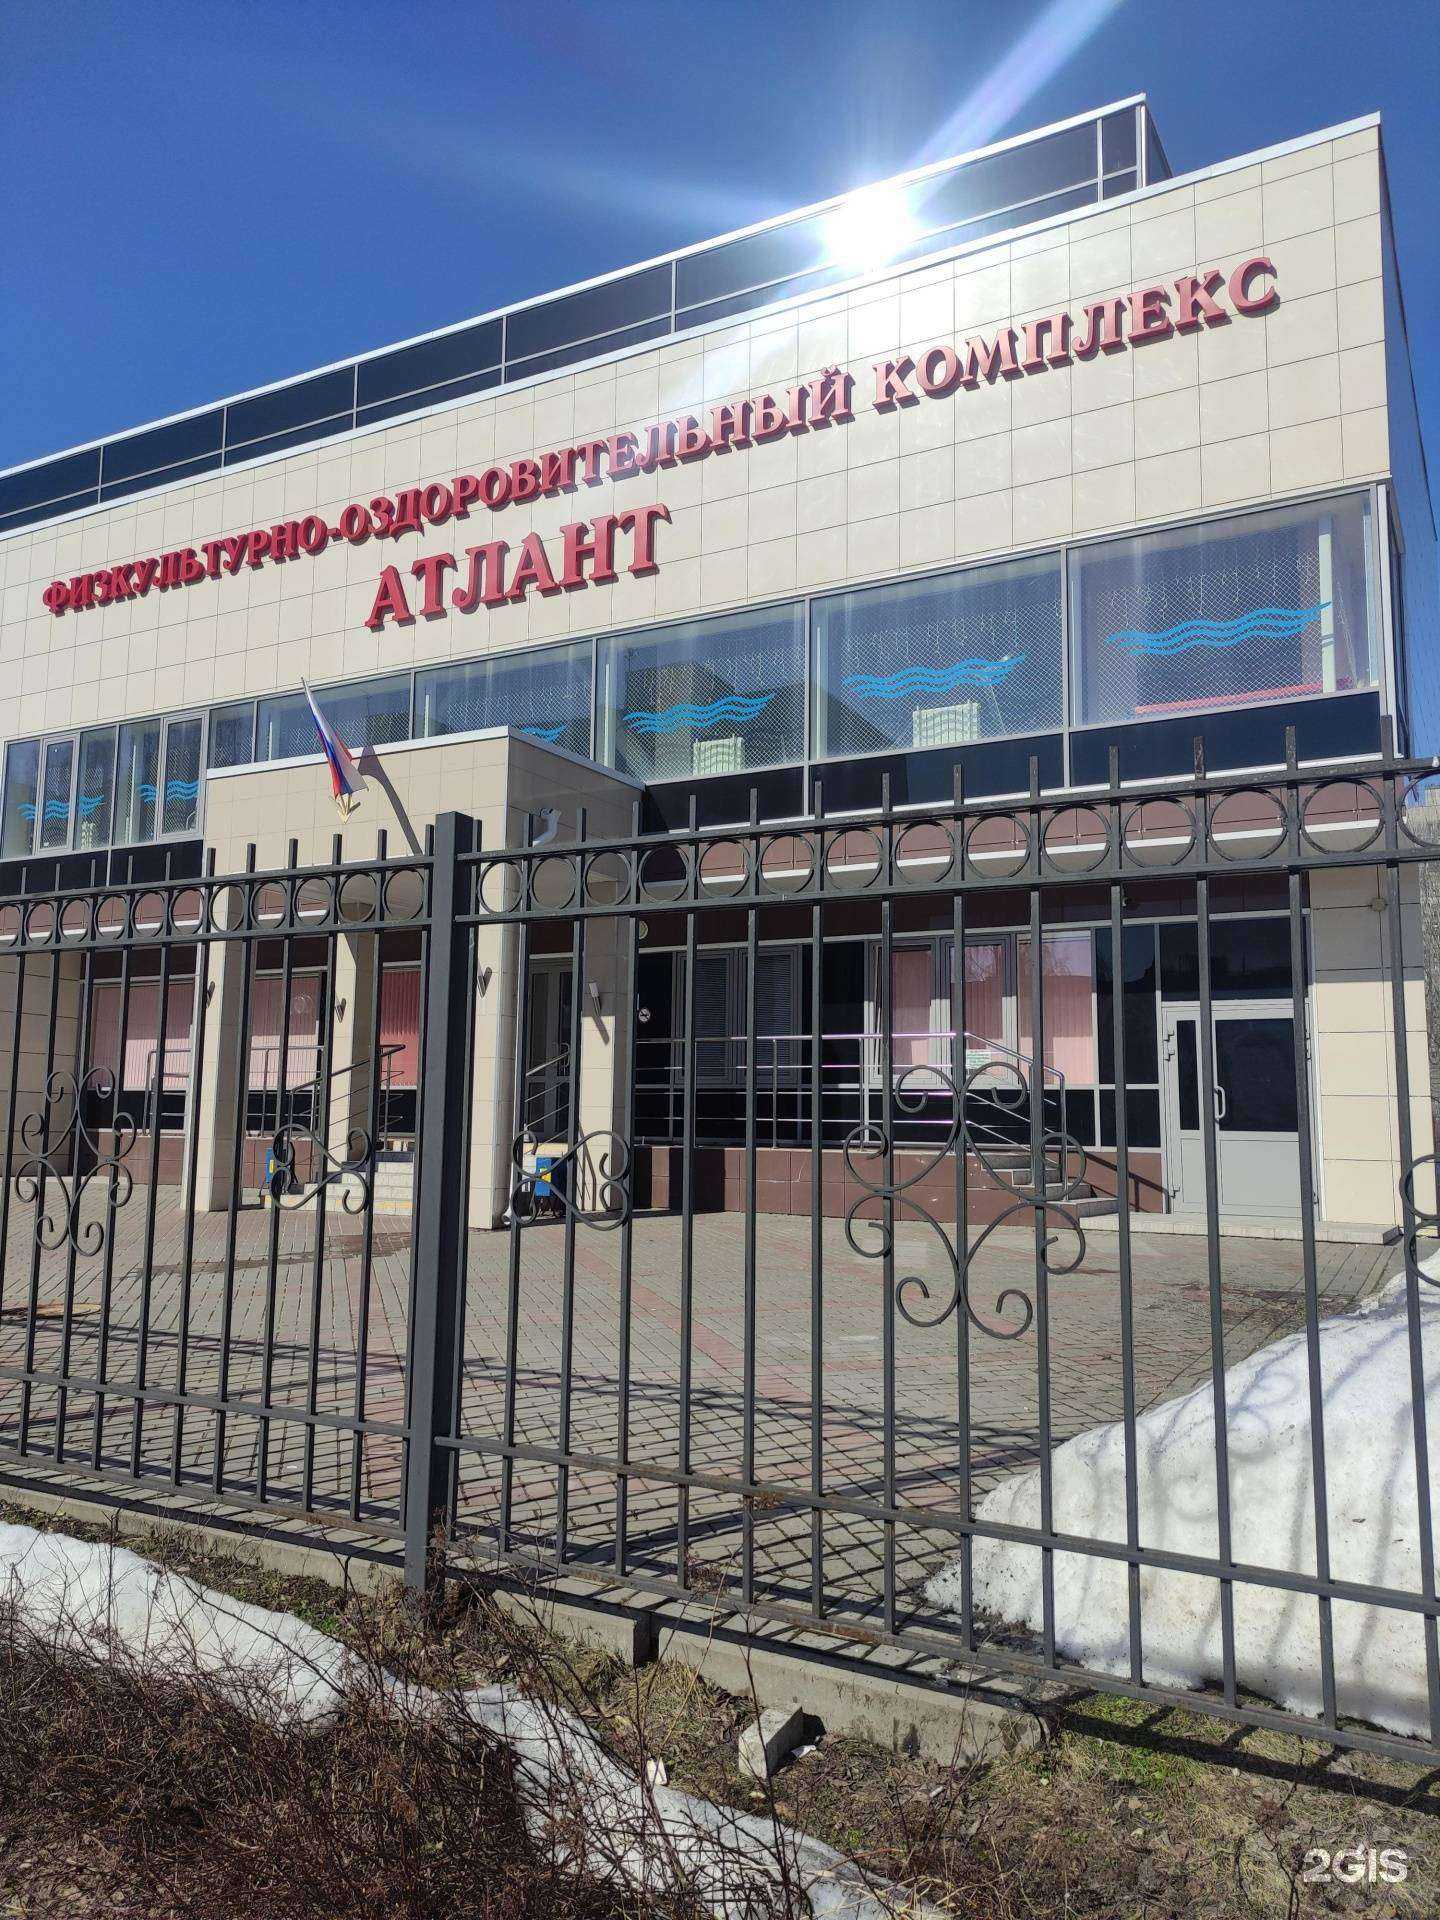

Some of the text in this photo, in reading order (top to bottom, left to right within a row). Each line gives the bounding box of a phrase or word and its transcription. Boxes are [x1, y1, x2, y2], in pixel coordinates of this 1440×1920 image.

[43, 257, 1279, 616] ФИЗКУЛЬТУРНО-ОЗДОРОВИТЕЛЬНЫЙ КОМПЛЕКС
[365, 503, 671, 631] АТЛАНТ
